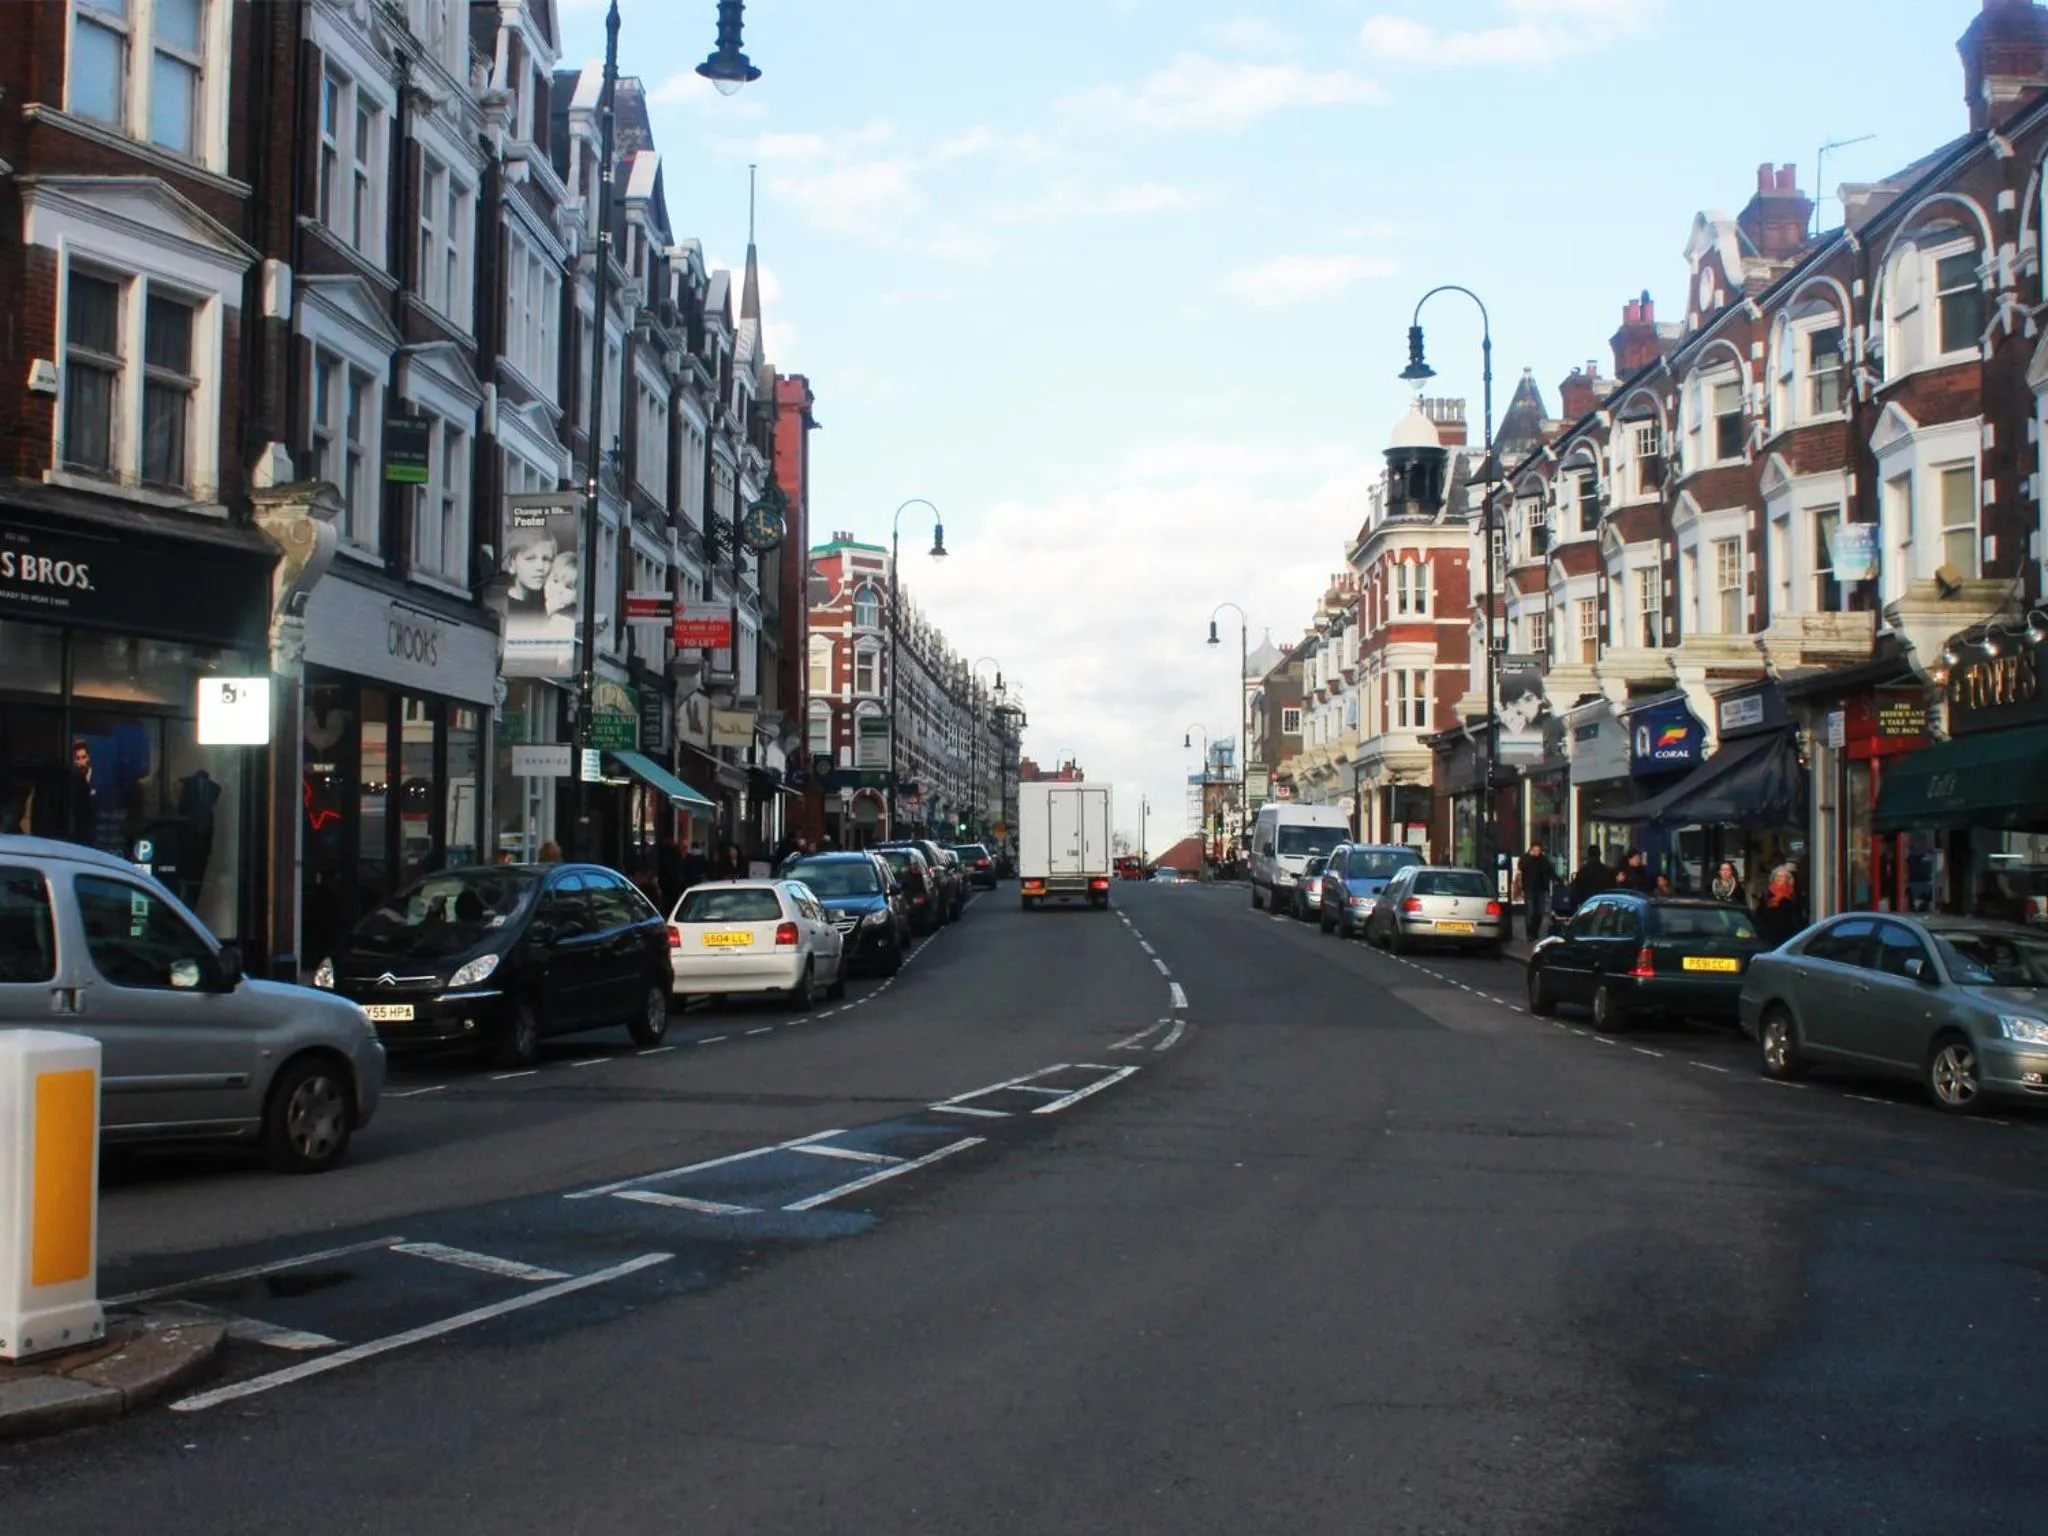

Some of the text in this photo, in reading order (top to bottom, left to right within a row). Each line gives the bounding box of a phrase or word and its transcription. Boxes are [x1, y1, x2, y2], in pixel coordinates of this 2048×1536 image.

[513, 517, 545, 527] Foster
[1, 551, 95, 591] S BROS.
[1655, 749, 1690, 759] CORAL
